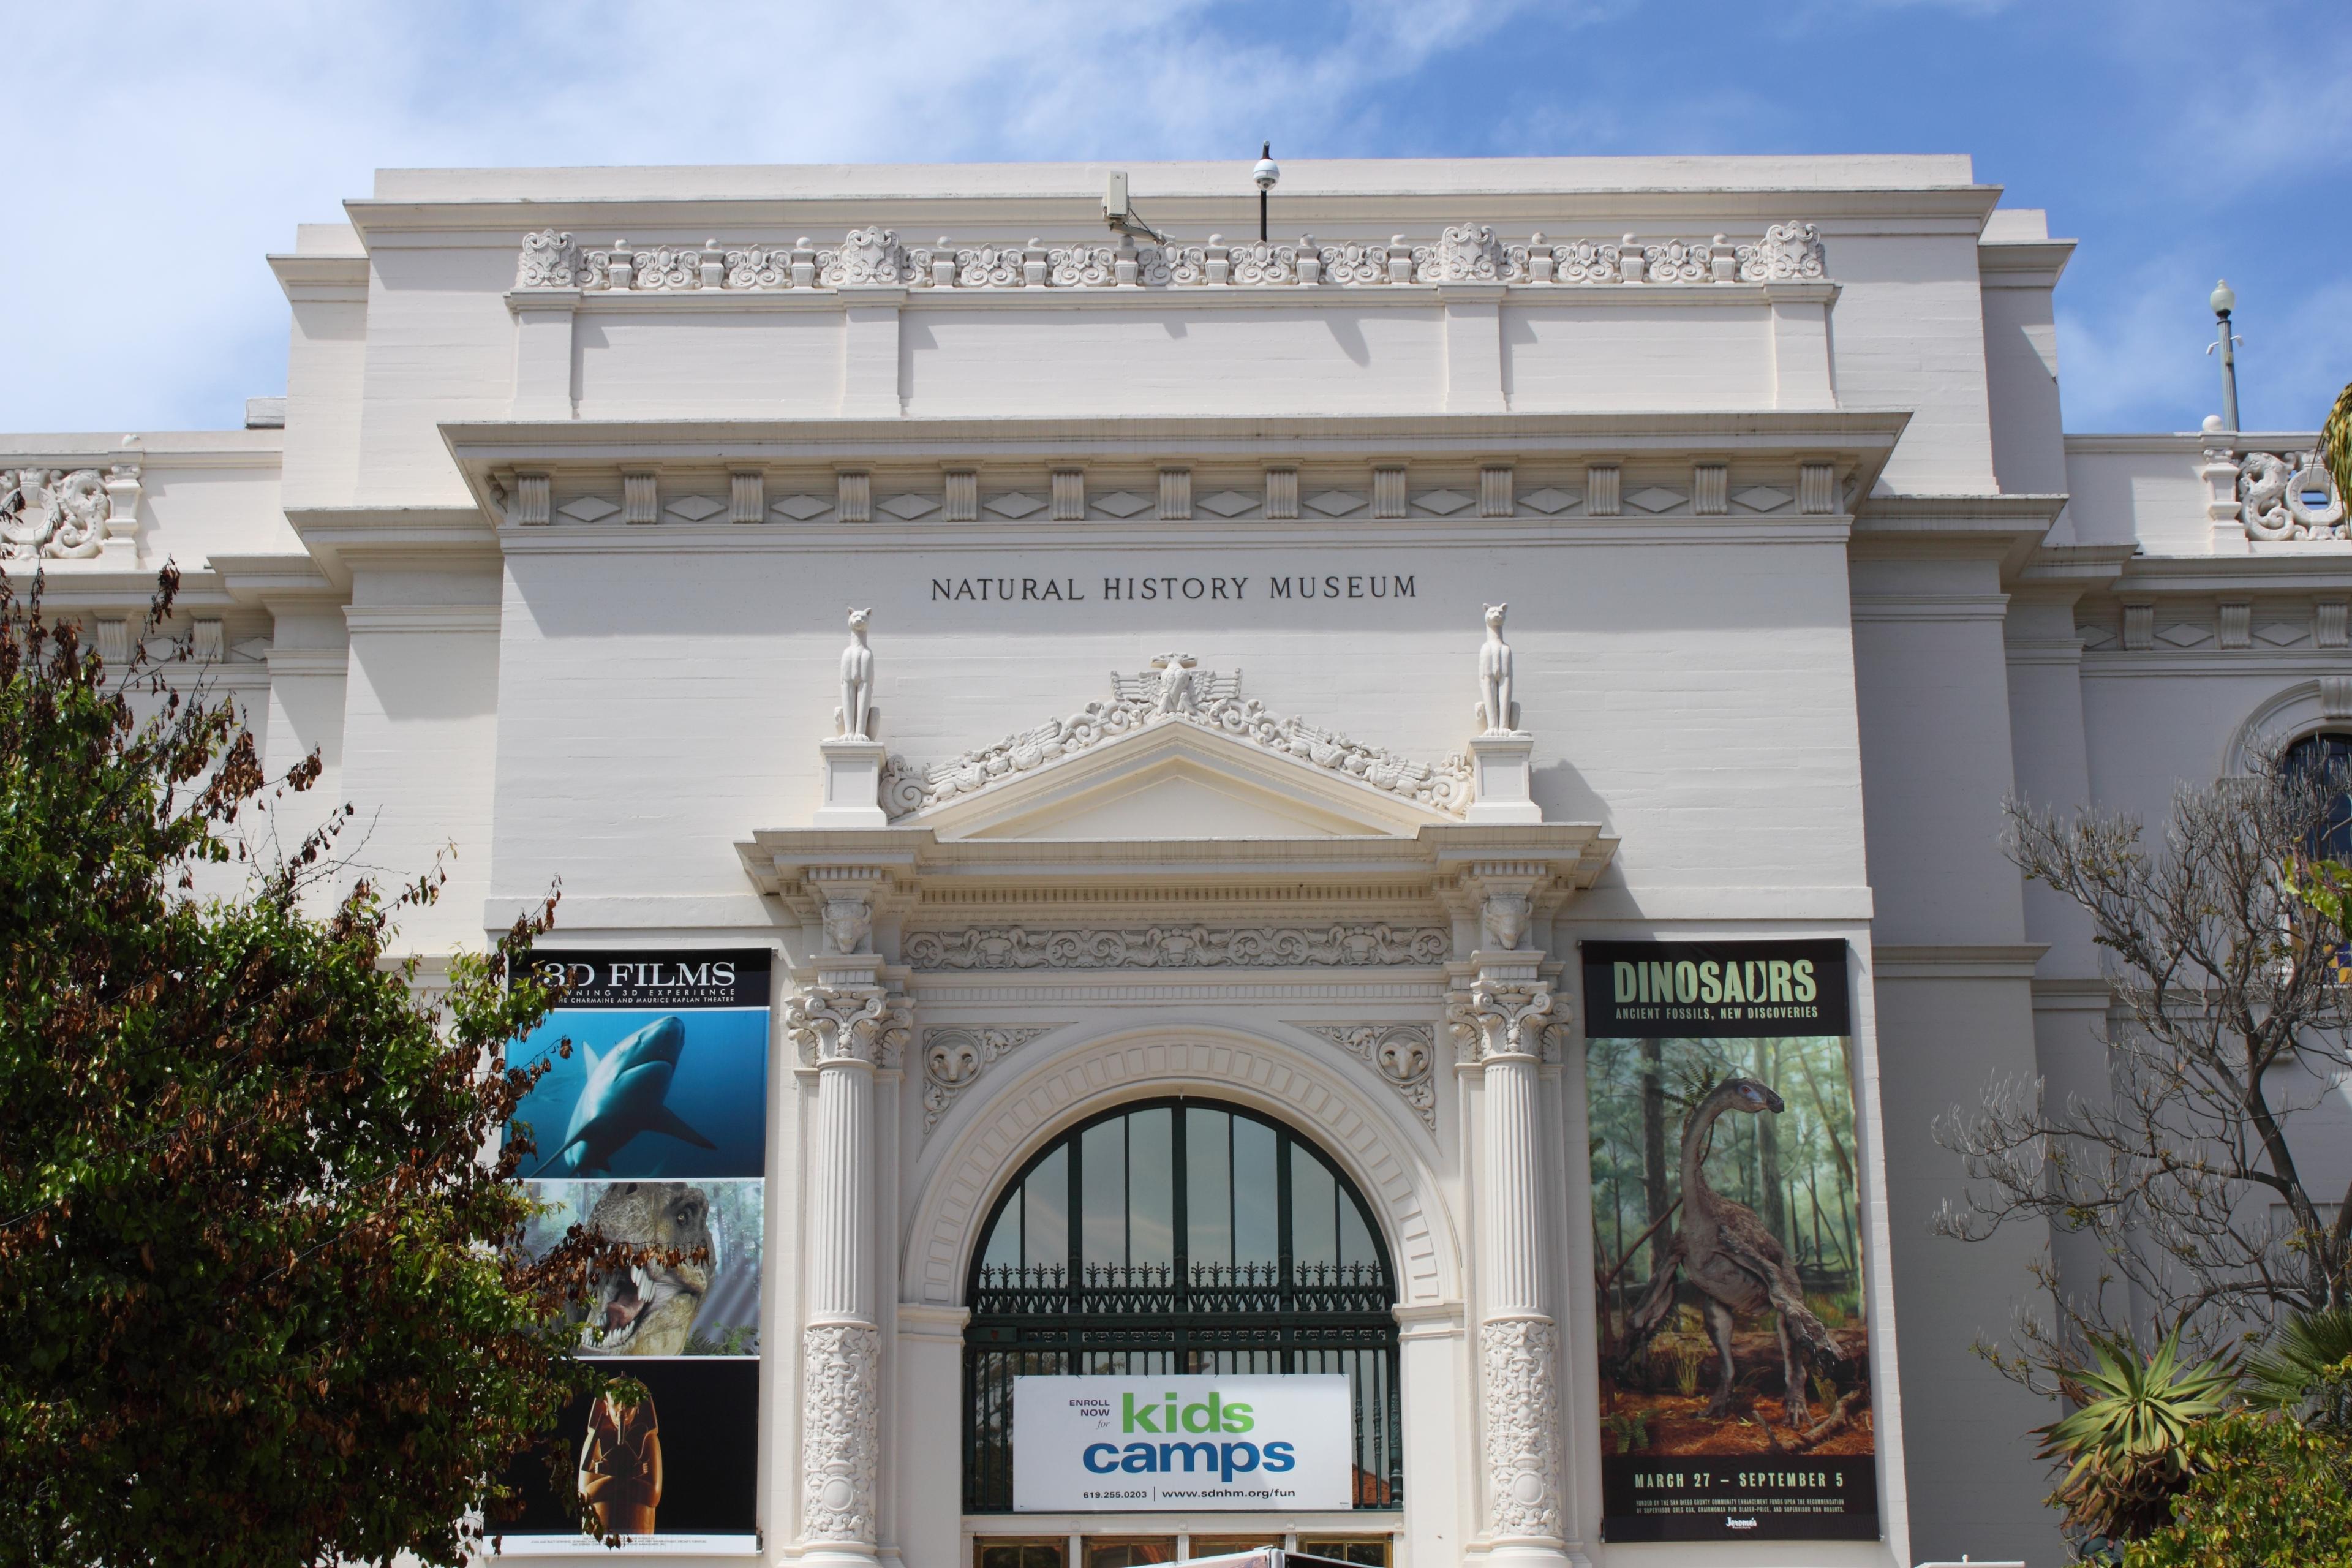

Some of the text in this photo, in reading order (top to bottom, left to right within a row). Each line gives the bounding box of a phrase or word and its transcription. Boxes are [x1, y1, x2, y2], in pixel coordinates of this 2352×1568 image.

[932, 576, 1415, 600] NATURAL HISTORY MUSEUM
[543, 962, 735, 987] 3D FILMS
[1615, 960, 1816, 1003] DINOSAURS
[1616, 1006, 1817, 1020] ANCIENT FOSSILS, NEW DISCOVERIES
[1096, 1419, 1110, 1429] for
[1123, 1392, 1254, 1433] kids
[1083, 1442, 1295, 1482] camps
[1635, 1474, 1683, 1487] MARCH
[1694, 1473, 1709, 1487] 27
[1740, 1473, 1825, 1487] SEPTEMBER
[1836, 1473, 1842, 1487] 5
[1162, 1489, 1295, 1499] www.sdnhm.org/fun
